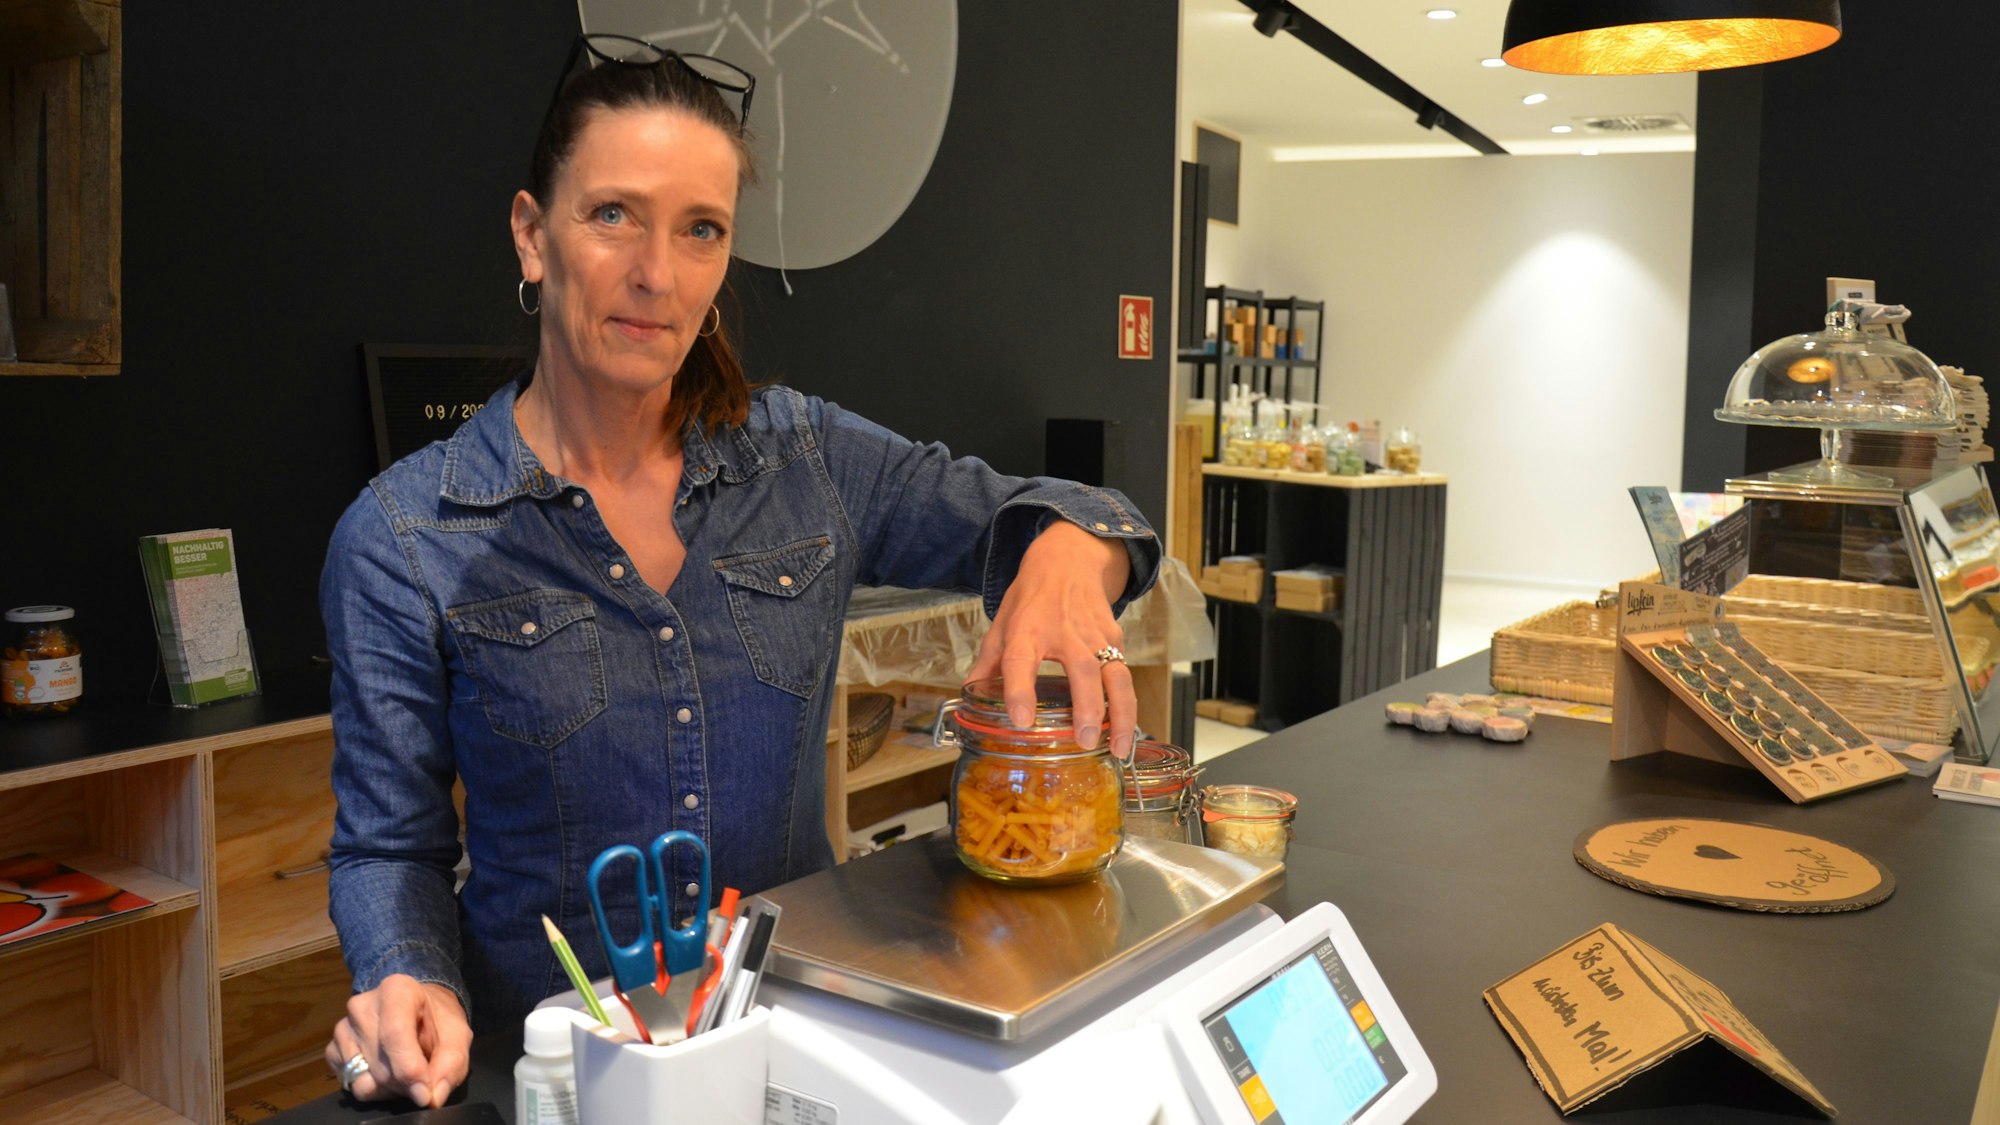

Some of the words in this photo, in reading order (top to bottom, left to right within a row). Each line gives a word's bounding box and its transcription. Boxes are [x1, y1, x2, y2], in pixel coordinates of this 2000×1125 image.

[172, 541, 225, 555] NACHHALTIG
[173, 552, 208, 565] BESSER
[48, 676, 77, 688] MANGO
[1626, 823, 1689, 847] haben
[1607, 849, 1650, 868] Wir
[1573, 942, 1605, 970] Bis
[1573, 1021, 1632, 1071] Mal!
